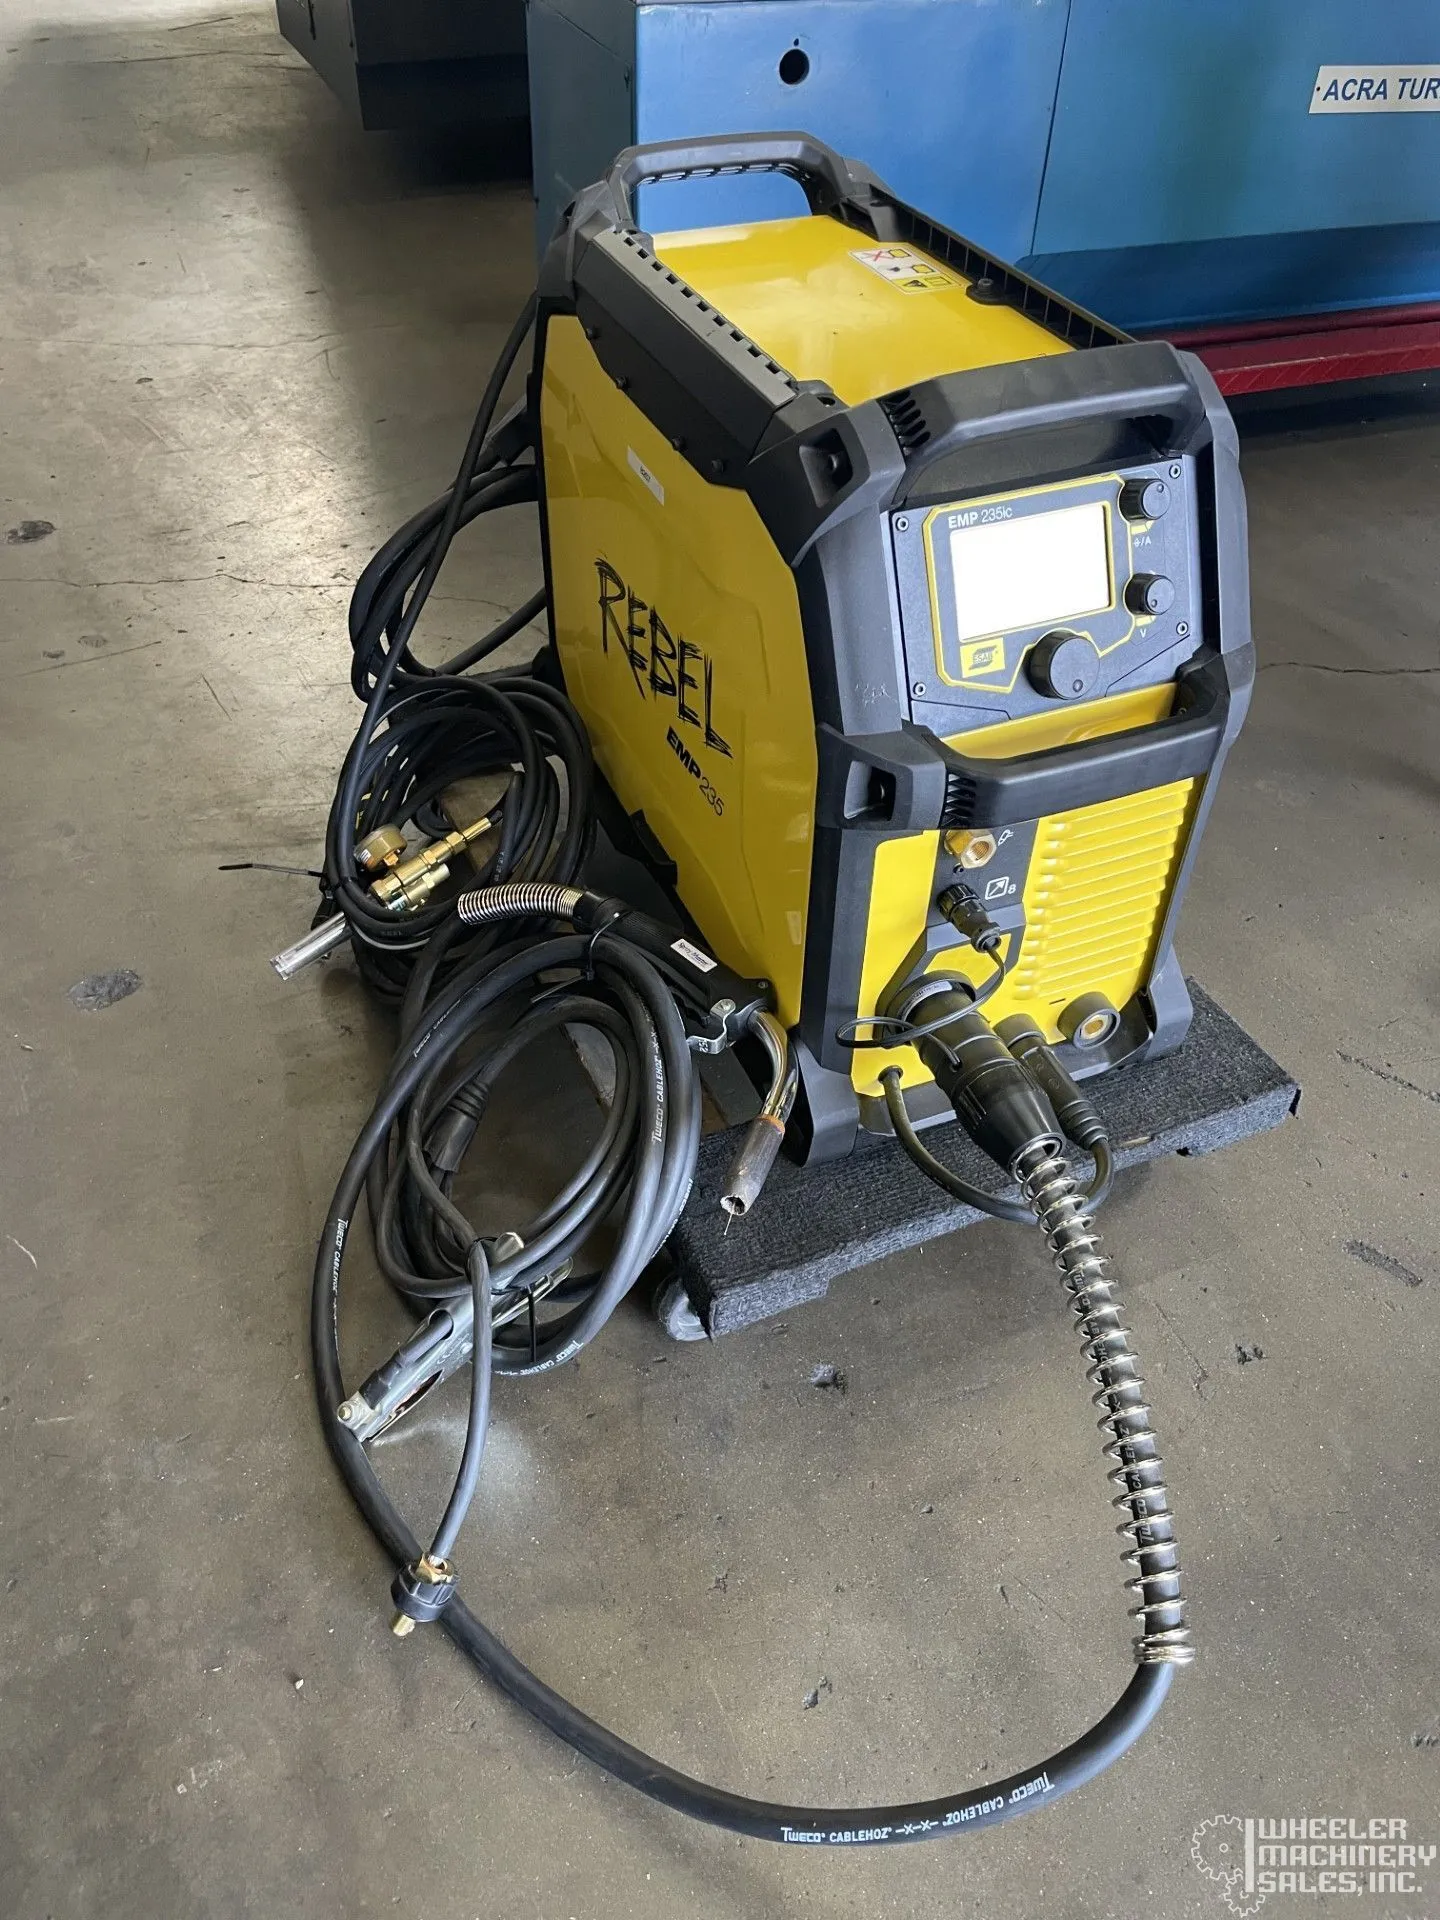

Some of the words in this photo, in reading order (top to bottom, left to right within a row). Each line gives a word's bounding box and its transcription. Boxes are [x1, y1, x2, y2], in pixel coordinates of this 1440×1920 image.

[1322, 78, 1388, 101] ACRA
[1398, 77, 1440, 100] TUR
[948, 511, 978, 529] EMP
[1140, 628, 1147, 638] V
[594, 557, 734, 759] REBEL
[1008, 884, 1016, 894] 8
